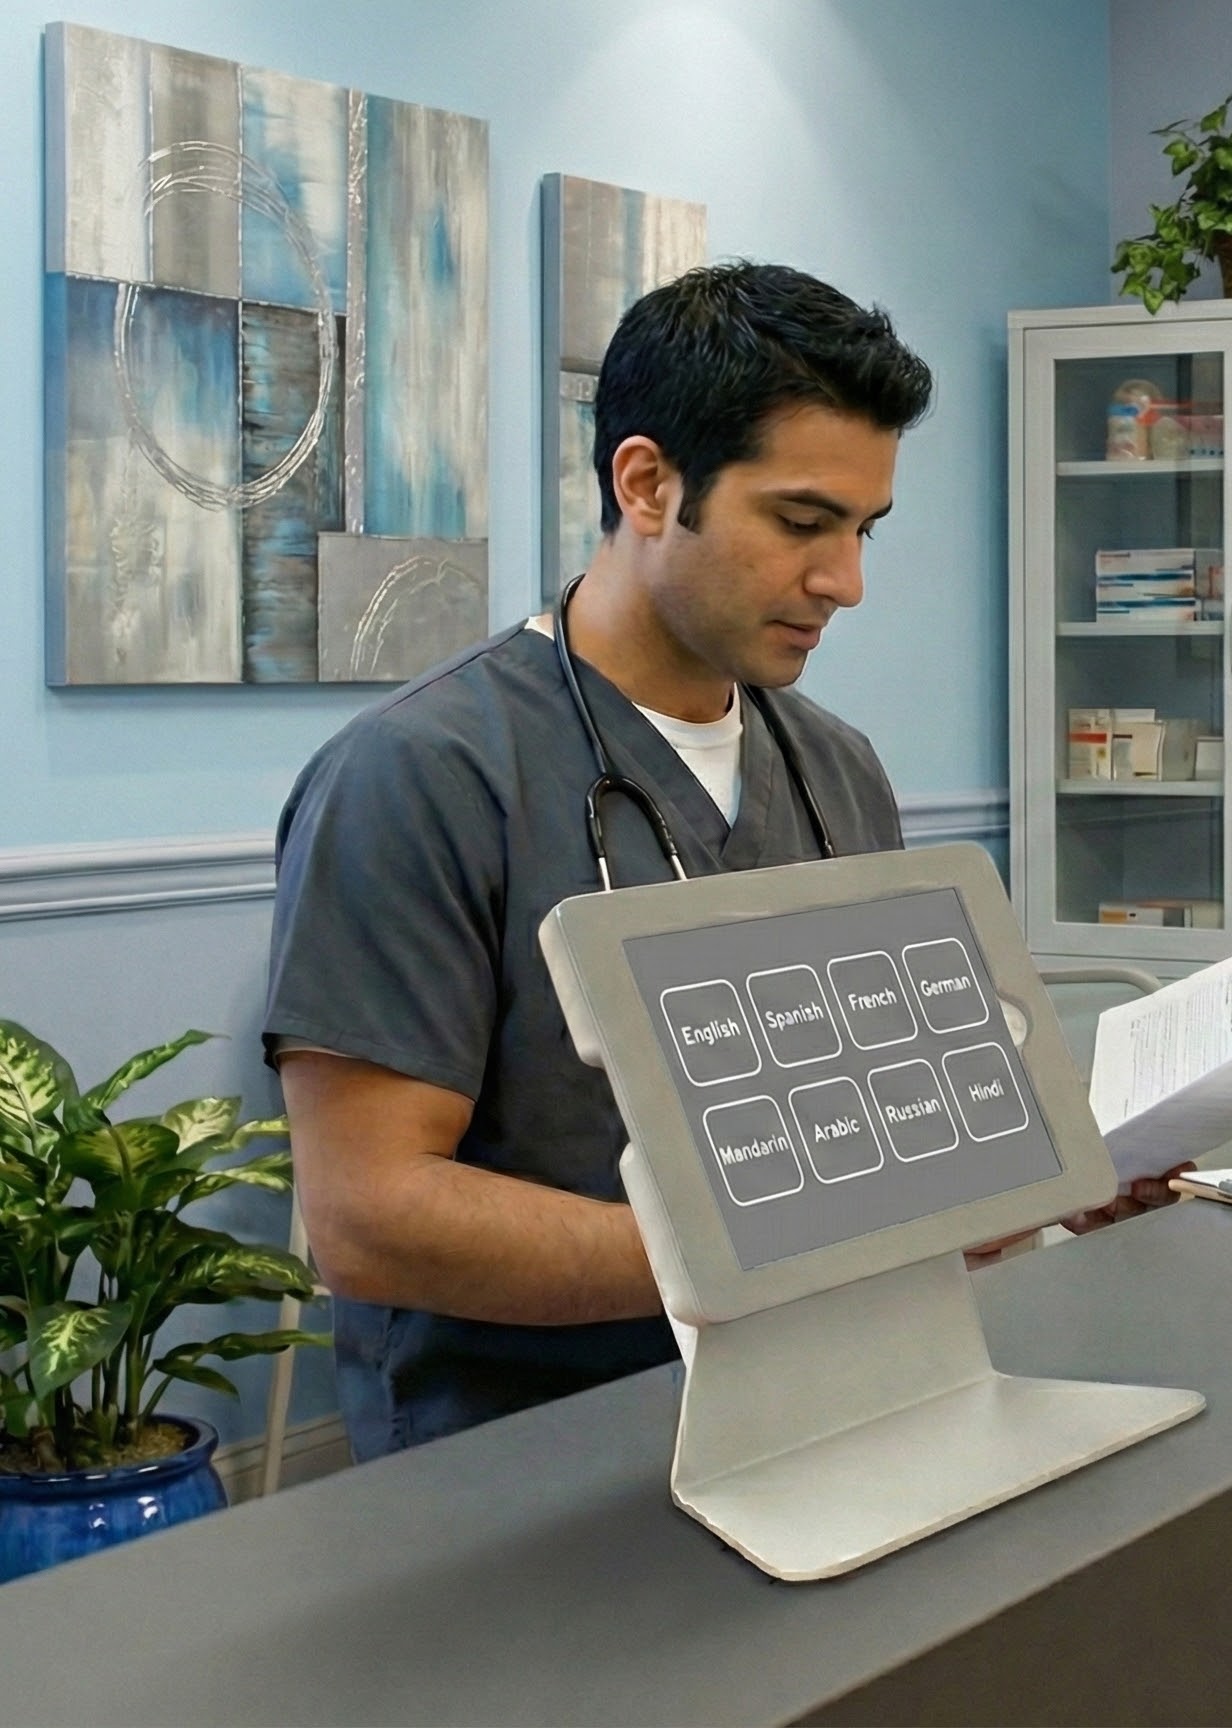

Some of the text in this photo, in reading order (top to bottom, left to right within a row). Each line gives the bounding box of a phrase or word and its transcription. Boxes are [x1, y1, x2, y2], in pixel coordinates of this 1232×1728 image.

[847, 987, 898, 1012] French
[920, 975, 972, 997] German
[765, 1001, 825, 1031] Spanish
[681, 1017, 741, 1046] English
[968, 1079, 1005, 1102] Hindi
[885, 1097, 942, 1124] Russian
[814, 1116, 861, 1143] Arabic
[718, 1134, 789, 1166] Mandarin
